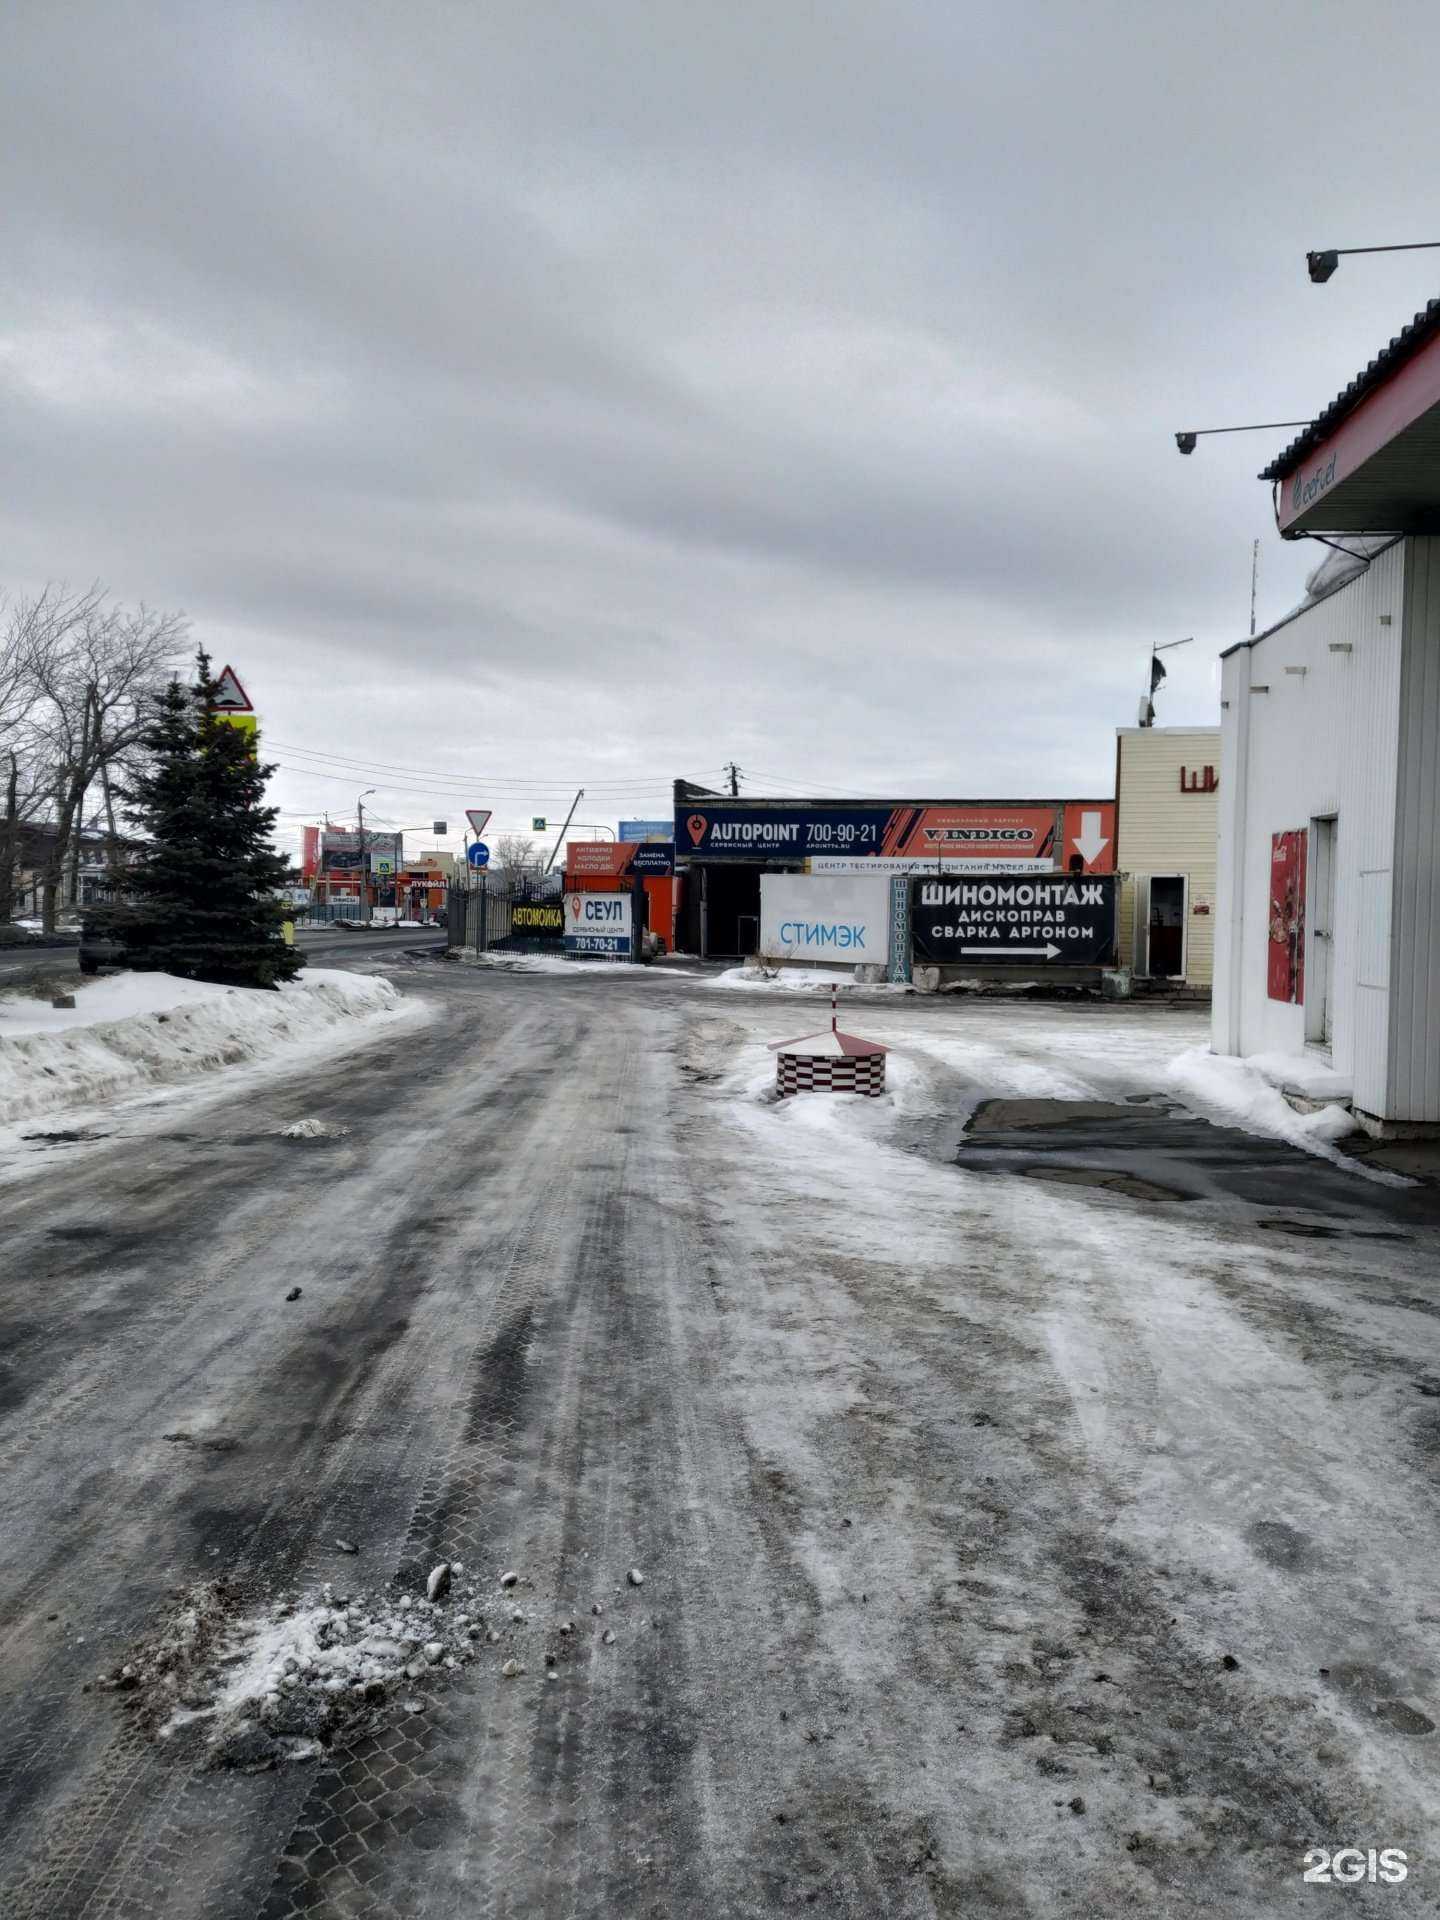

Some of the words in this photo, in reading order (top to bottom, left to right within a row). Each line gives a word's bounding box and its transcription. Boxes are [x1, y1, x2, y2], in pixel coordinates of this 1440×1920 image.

[710, 823, 800, 841] AUTOPOINT
[806, 824, 876, 842] 700-90-21
[923, 828, 1034, 841] WINDIGO
[921, 884, 1104, 905] ШИНОМОНТАЖ
[512, 906, 562, 926] АВТОМОЙКА
[585, 900, 622, 920] СЕУЛ
[958, 910, 1065, 922] ДИСКОПРАВ
[780, 922, 866, 948] СТИМЭК
[931, 926, 1000, 938] СВАРКА
[1009, 926, 1094, 938] АРГОНОМ
